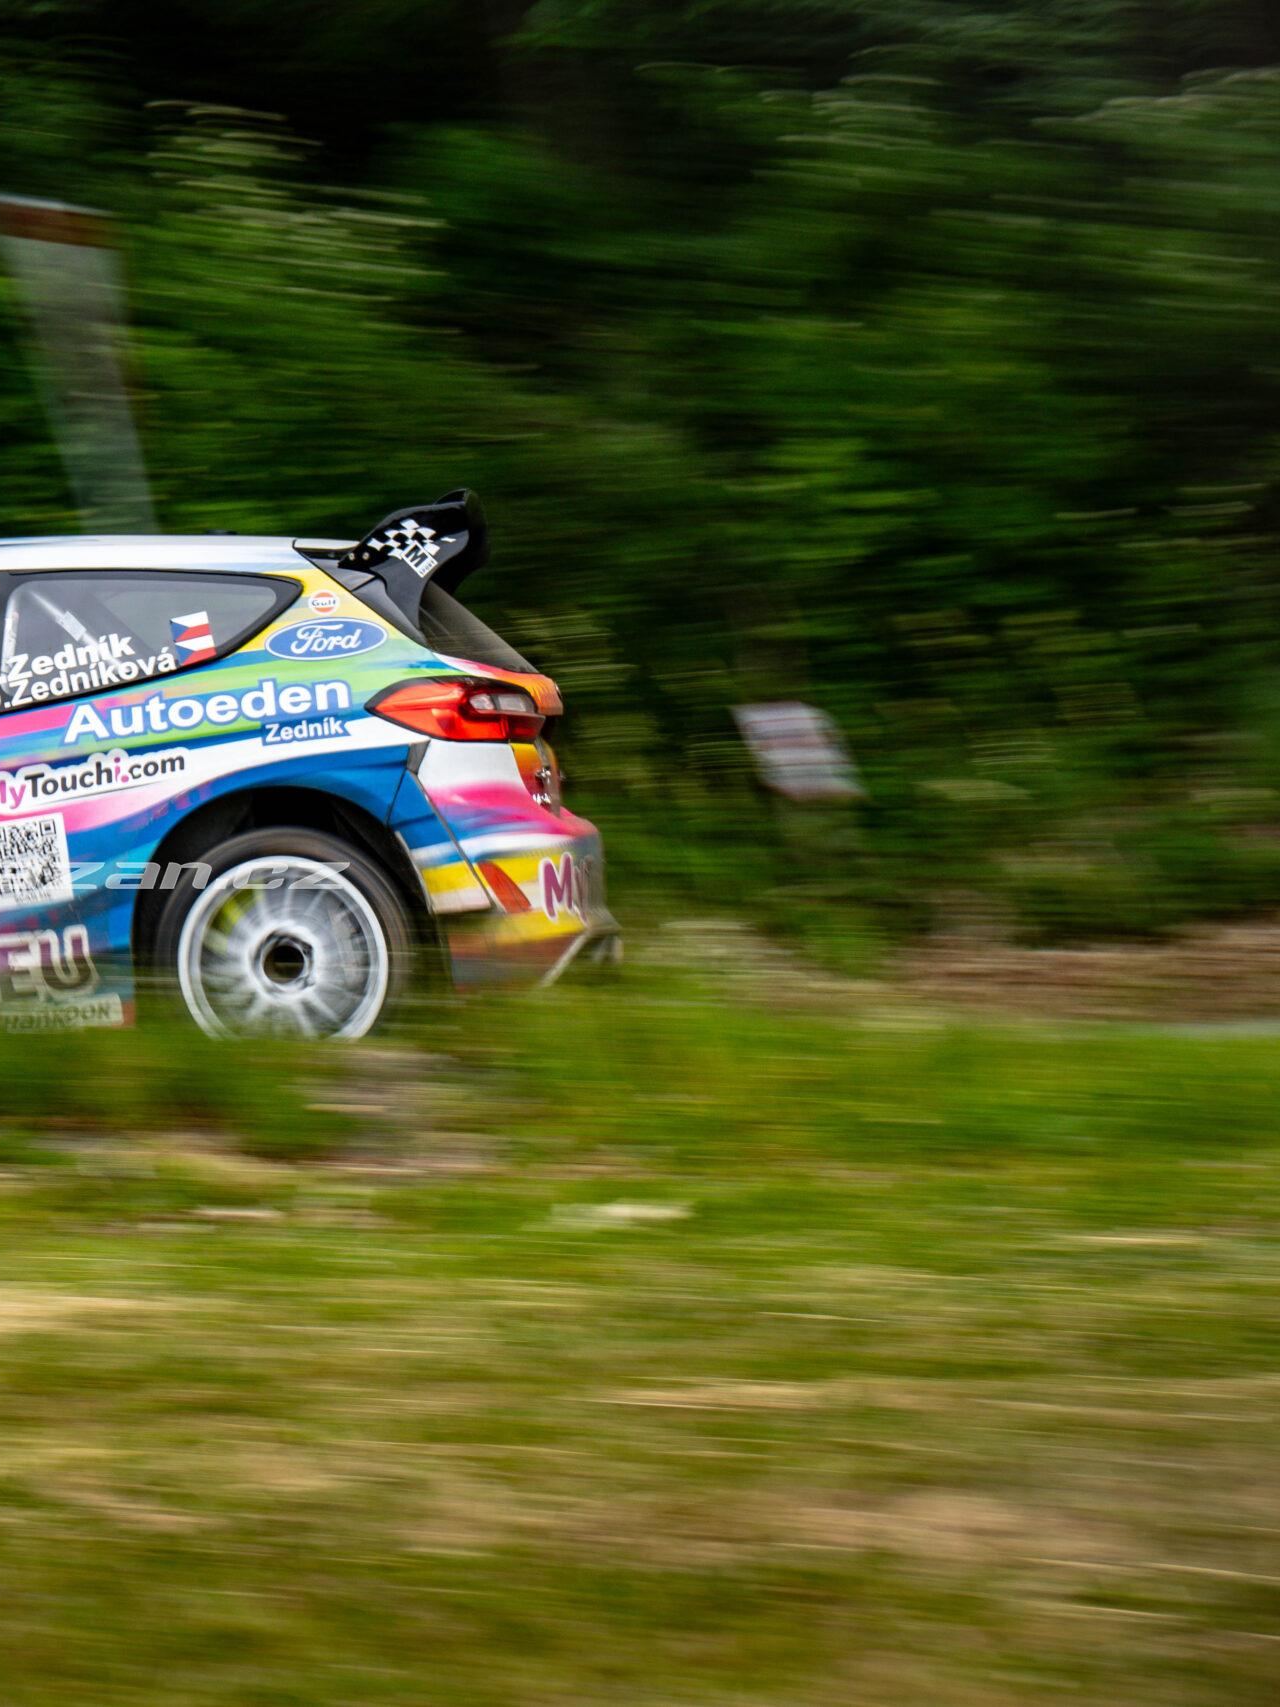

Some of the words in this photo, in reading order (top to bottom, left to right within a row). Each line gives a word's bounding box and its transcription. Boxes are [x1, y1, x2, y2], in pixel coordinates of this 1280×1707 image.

[405, 545, 428, 568] M
[290, 623, 363, 654] Ford
[63, 680, 350, 744] Autoeden
[265, 717, 344, 743] Zedník
